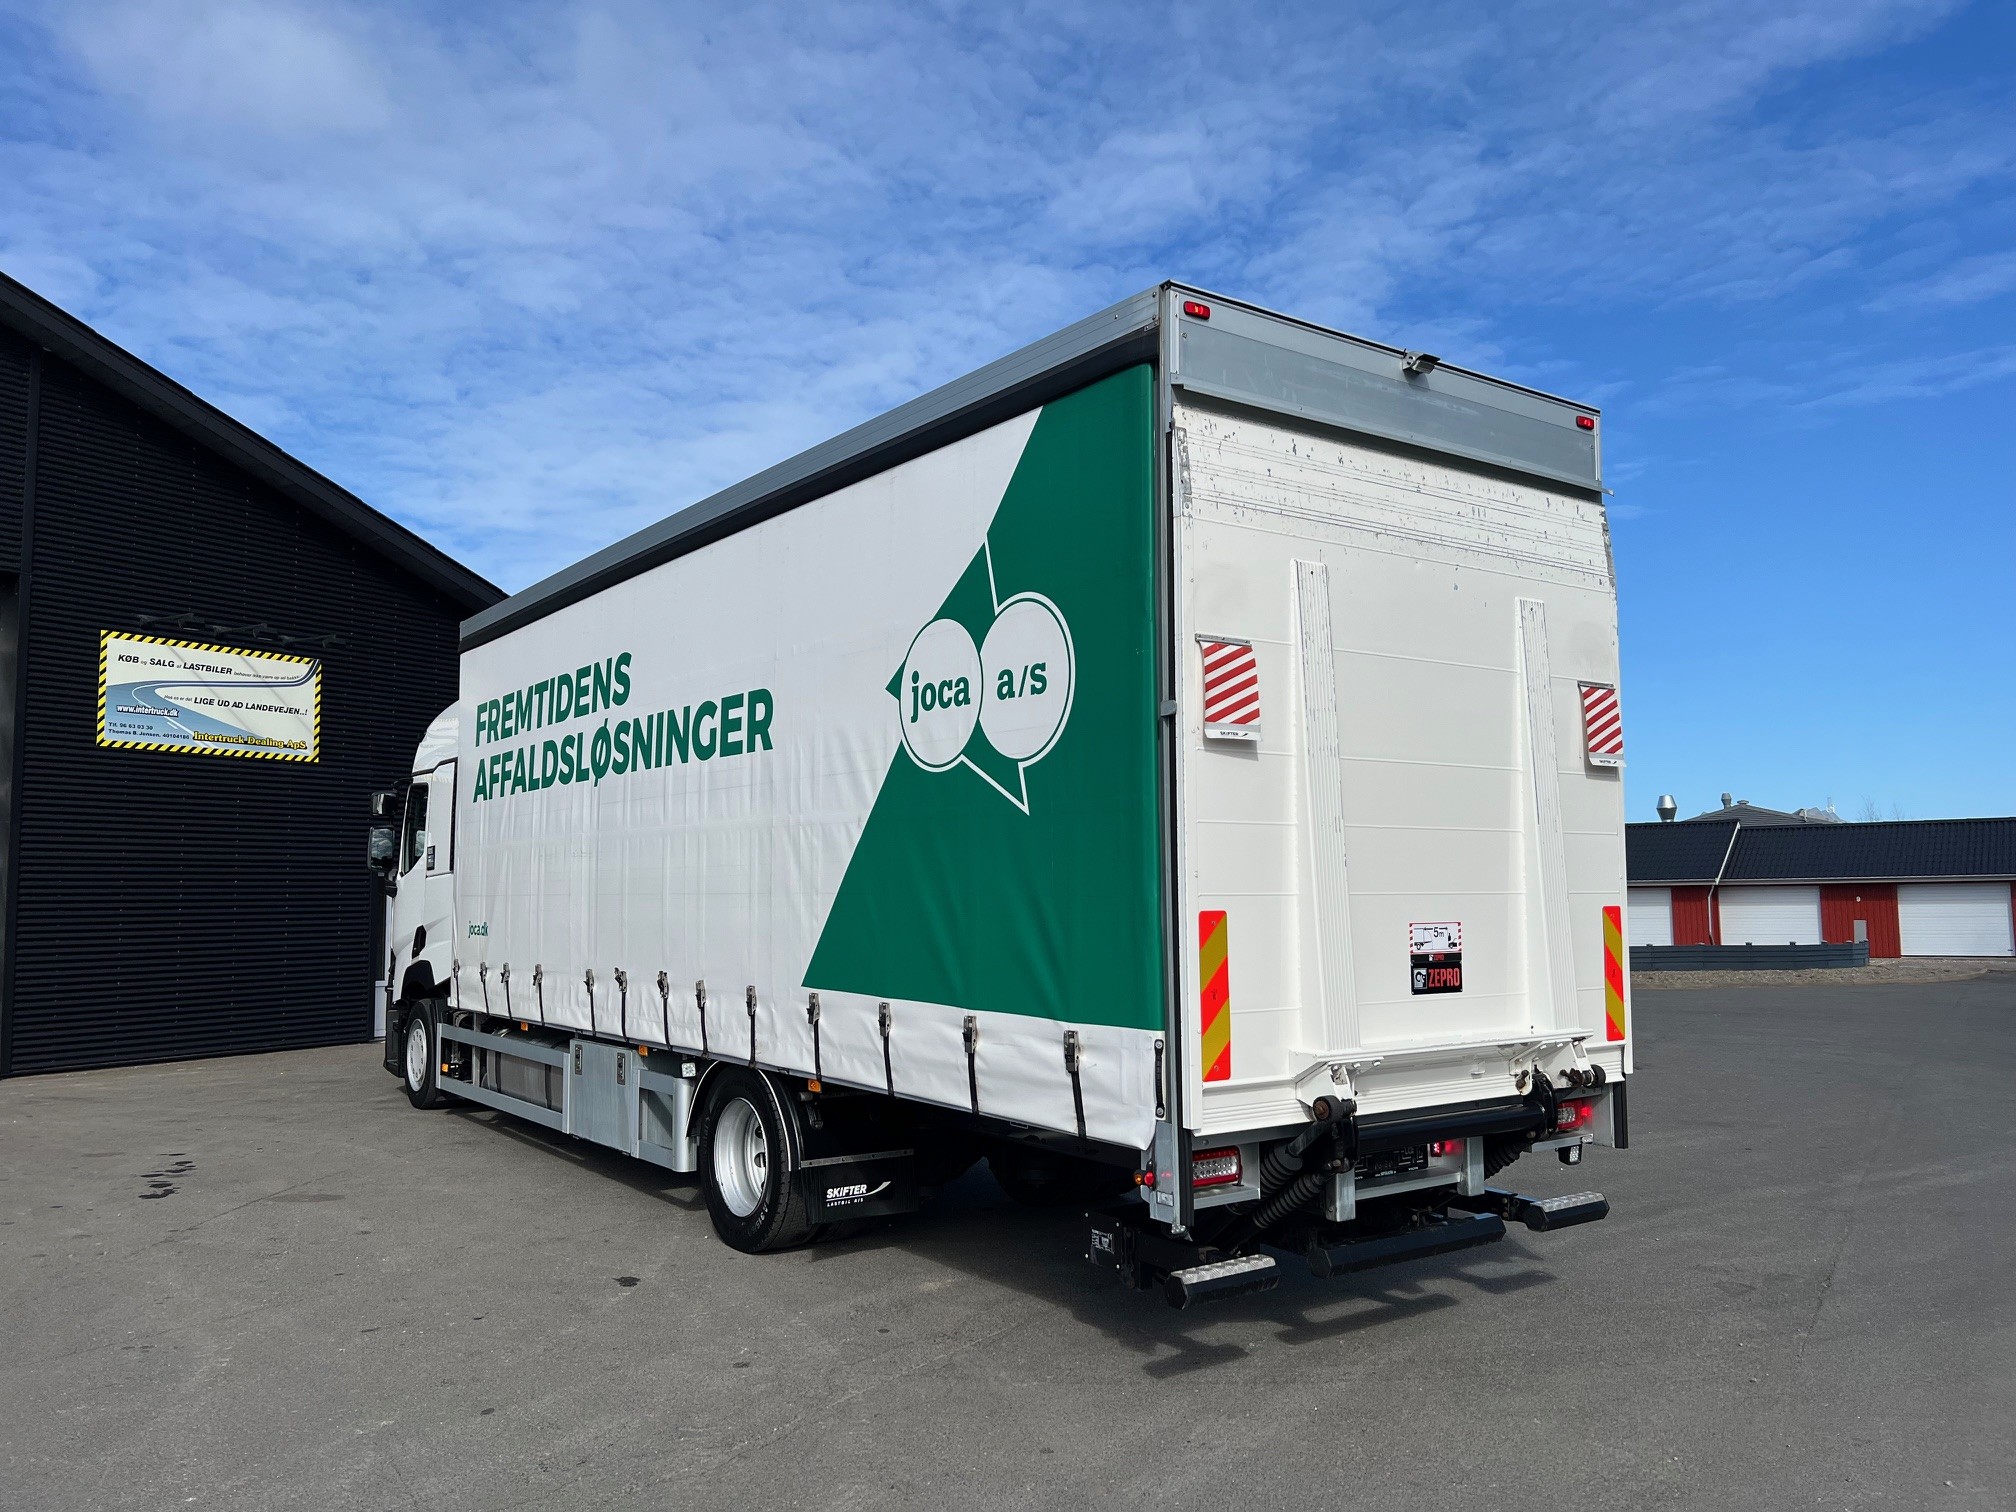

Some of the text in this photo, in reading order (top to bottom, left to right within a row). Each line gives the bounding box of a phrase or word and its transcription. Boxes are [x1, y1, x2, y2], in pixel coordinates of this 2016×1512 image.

[118, 654, 139, 664] KØB
[150, 658, 175, 668] SALG
[183, 662, 232, 676] LASTBILER
[475, 652, 632, 748] FREMTIDENS
[910, 662, 1048, 724] joca a/s
[117, 705, 178, 717] www.intertruck.dk
[194, 696, 215, 706] LIGE
[218, 700, 230, 708] UD
[231, 701, 243, 709] AD
[245, 702, 308, 716] LANDEVEJEN..!
[193, 731, 307, 749] Intertruck Dealing ApS
[473, 688, 774, 803] AFFALDSLØSNINGER
[468, 920, 489, 938] joca.dk
[1428, 968, 1460, 987] ZEPRO
[826, 1184, 868, 1198] SKIFTER
